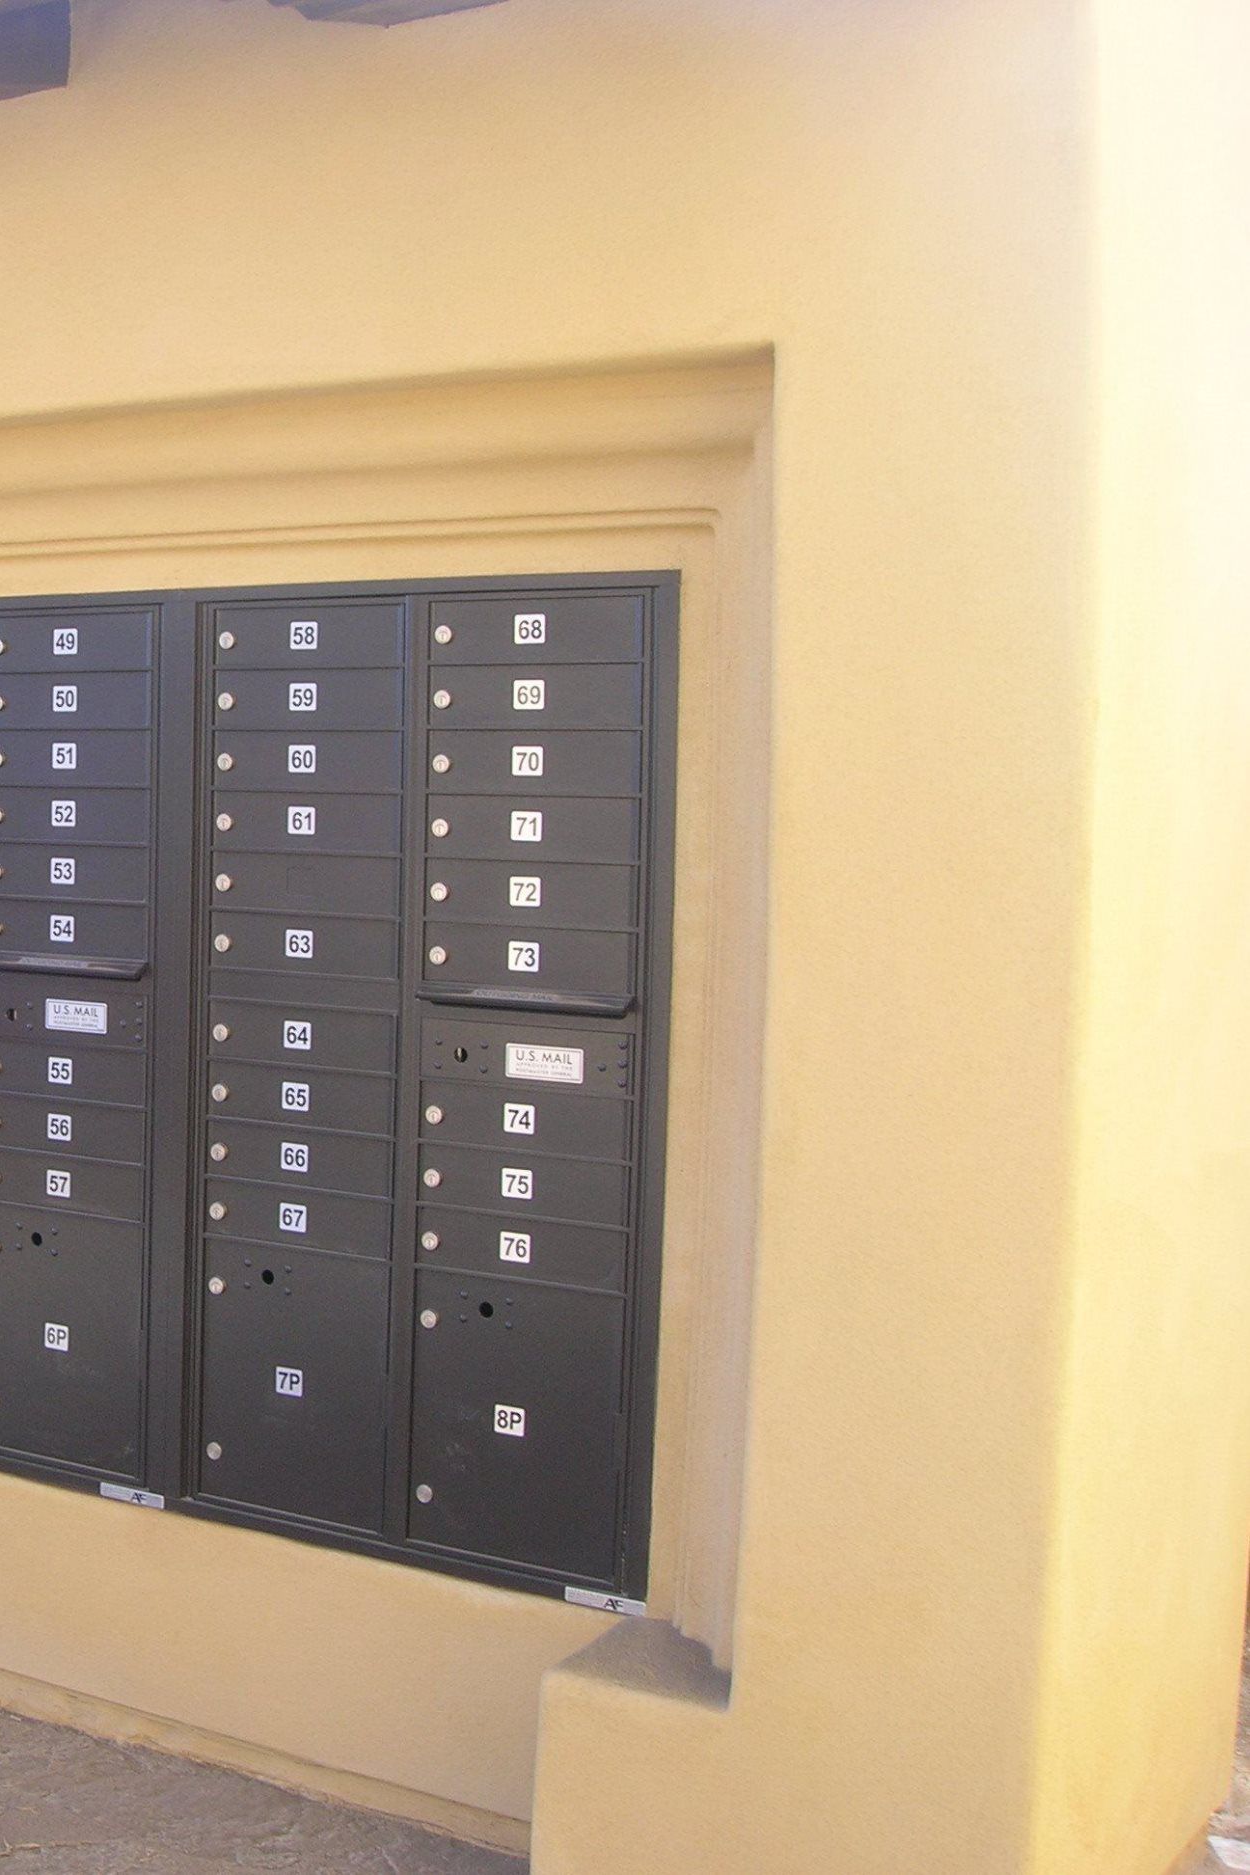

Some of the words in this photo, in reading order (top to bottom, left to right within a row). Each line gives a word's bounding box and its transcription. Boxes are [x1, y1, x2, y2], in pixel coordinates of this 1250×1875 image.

[292, 626, 315, 646] 58
[518, 619, 543, 640] 68
[55, 632, 76, 651] 49
[55, 689, 75, 708] 50
[292, 688, 314, 708] 59
[517, 685, 542, 705] 69
[55, 747, 73, 765] 51
[291, 749, 314, 769] 60
[515, 751, 540, 772] 70
[54, 805, 73, 823] 52
[292, 811, 312, 831] 61
[516, 816, 537, 837] 71
[53, 862, 73, 881] 53
[513, 882, 537, 902] 72
[52, 919, 73, 938] 54
[288, 934, 311, 954] 63
[512, 947, 536, 968] 73
[53, 1004, 71, 1015] U.S.
[73, 1006, 99, 1018] MAIL
[286, 1025, 309, 1045] 64
[515, 1049, 538, 1062] U.S.
[541, 1052, 573, 1065] MAIL
[50, 1061, 70, 1081] 55
[284, 1087, 307, 1108] 65
[49, 1117, 70, 1137] 56
[507, 1108, 531, 1130] 74
[283, 1147, 306, 1168] 66
[49, 1174, 69, 1193] 57
[505, 1173, 529, 1195] 75
[282, 1207, 304, 1228] 67
[503, 1236, 528, 1259] 76
[46, 1326, 67, 1346] 6P
[278, 1371, 301, 1391] 7P
[496, 1409, 523, 1430] 8P
